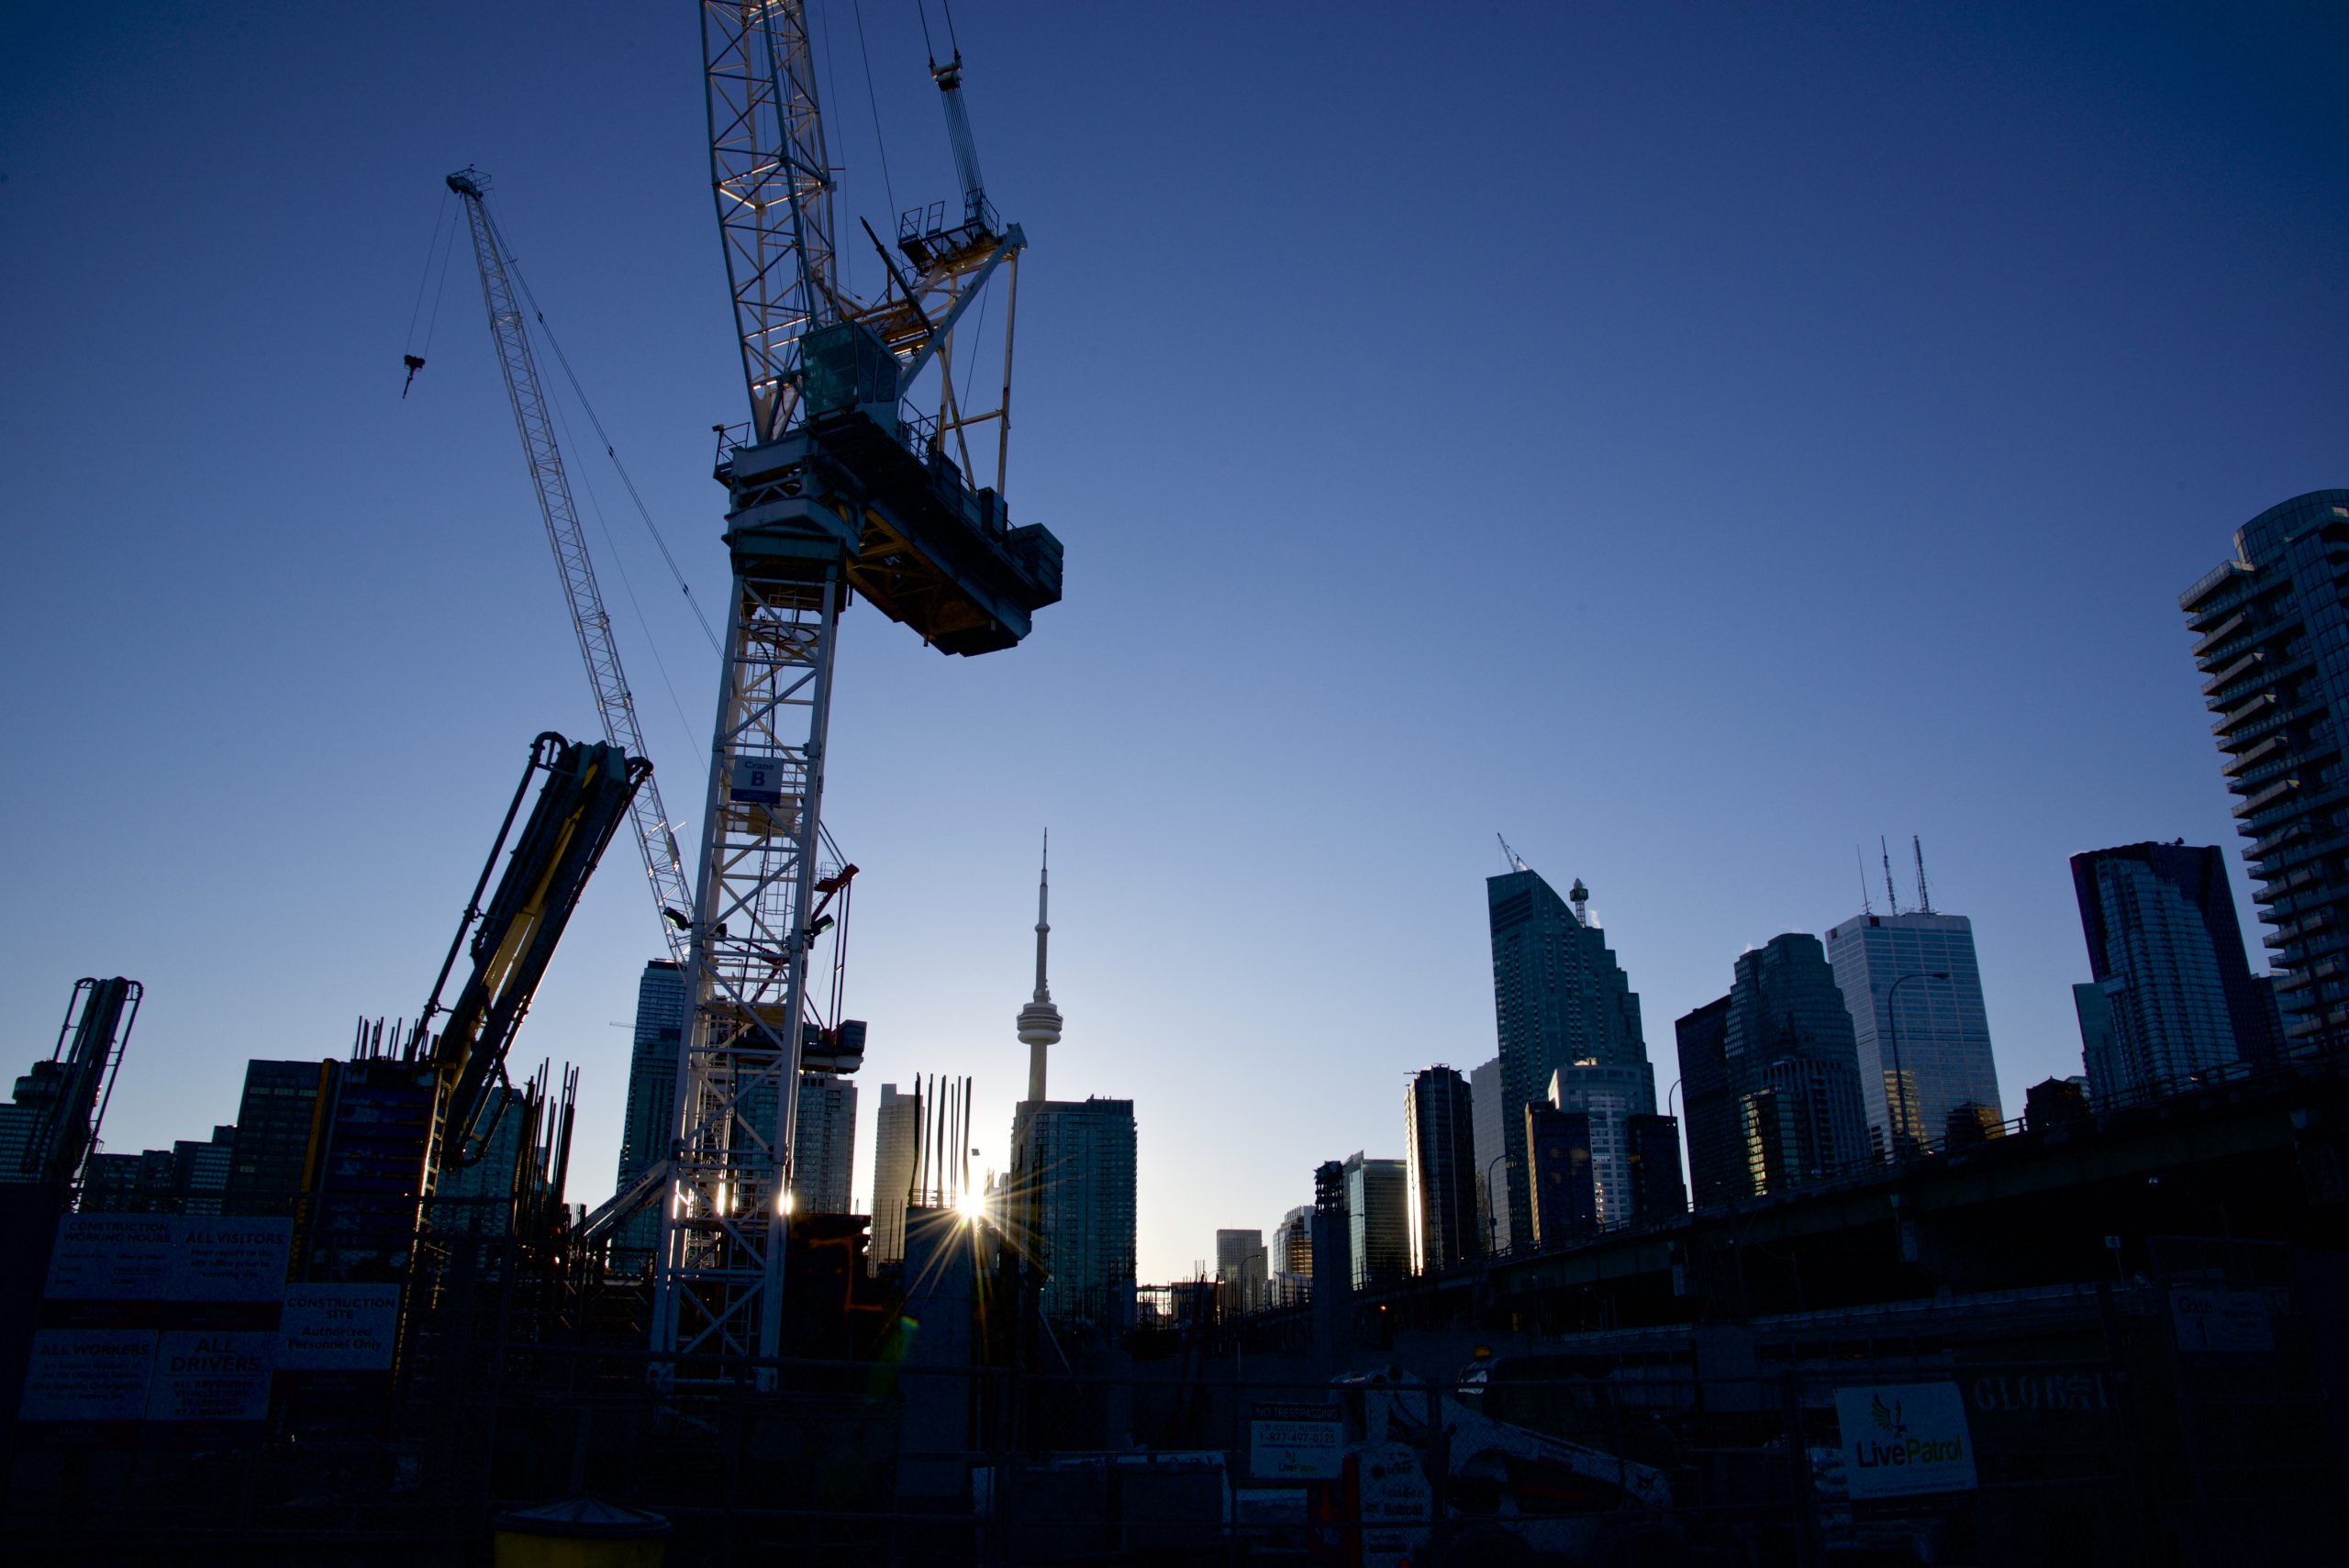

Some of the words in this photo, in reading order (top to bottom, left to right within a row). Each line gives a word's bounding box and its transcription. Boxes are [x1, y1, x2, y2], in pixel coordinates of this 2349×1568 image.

[744, 761, 774, 770] Crane
[751, 771, 765, 786] B
[603, 1173, 650, 1211] PUMPCRETE
[69, 1222, 170, 1231] CONSTRUCTION
[63, 1233, 125, 1241] WORKING
[127, 1234, 171, 1242] HOURS
[185, 1232, 214, 1243] ALL
[216, 1233, 284, 1244] VISITORS
[215, 1250, 244, 1258] report
[287, 1298, 395, 1308] CONSTRUCTION
[2179, 1295, 2213, 1314] Gate
[325, 1310, 353, 1319] SITE
[301, 1326, 372, 1337] Authorized
[2196, 1318, 2208, 1347] 1
[39, 1344, 70, 1355] ALL
[73, 1344, 149, 1355] WORKERS
[195, 1338, 235, 1352] ALL
[288, 1340, 349, 1349] Personnel
[352, 1340, 382, 1351] Only
[171, 1357, 260, 1372] DRIVERS
[1255, 1407, 1271, 1418] NO
[1274, 1407, 1338, 1419] TRESSPASSING
[1259, 1432, 1336, 1443] 1-877-497-0125
[1856, 1435, 1964, 1469] LivePatrol
[1384, 1502, 1423, 1517] Bobcat
